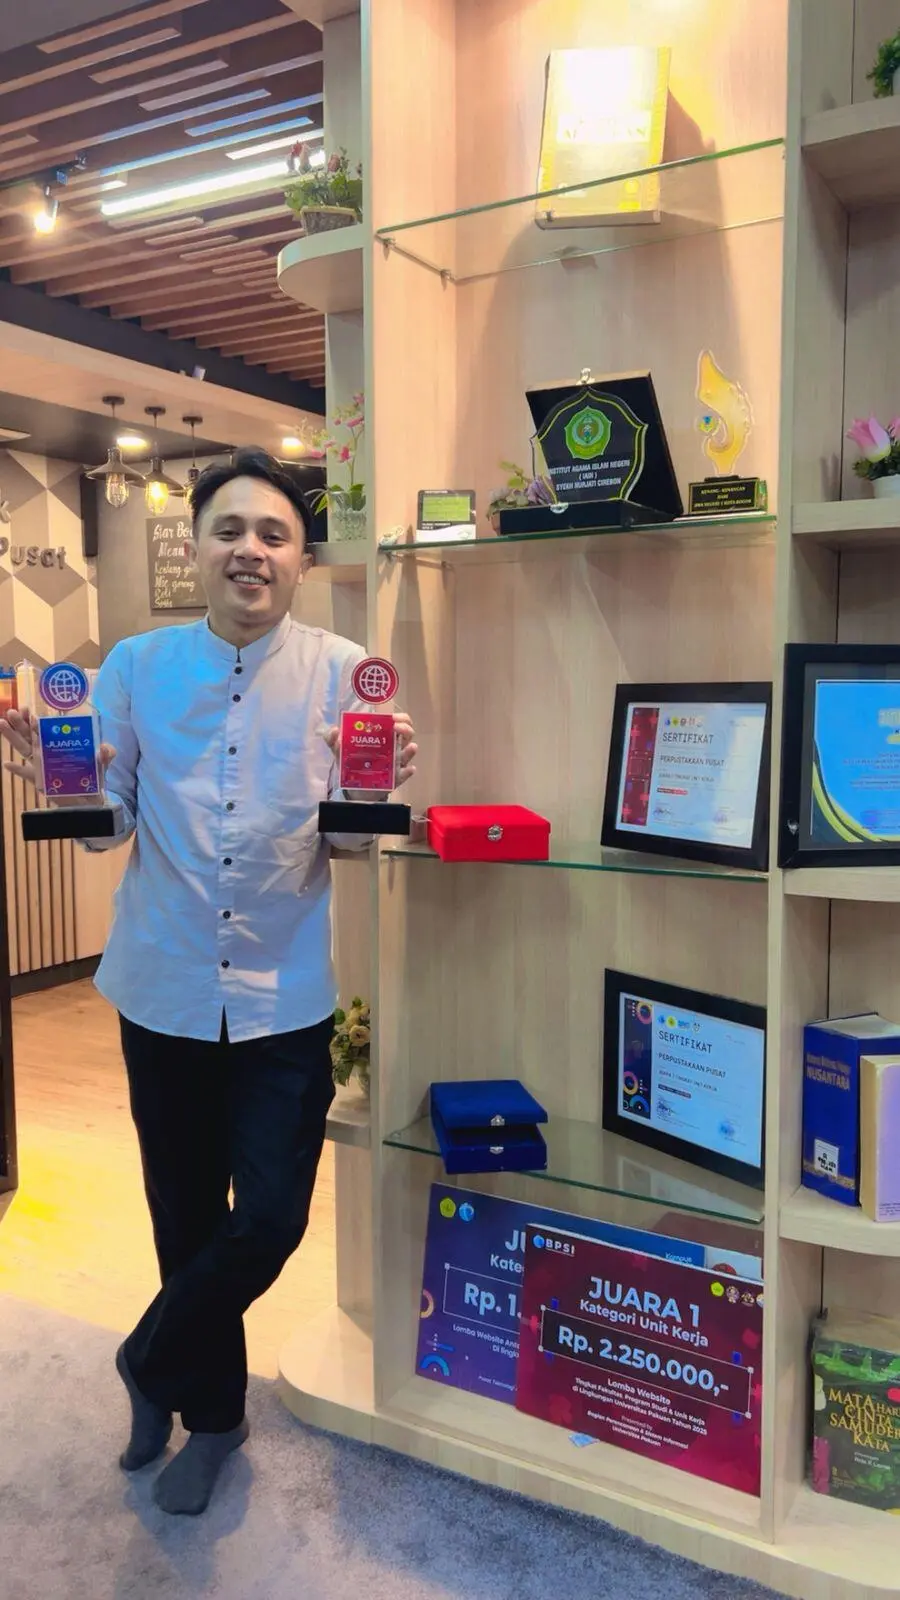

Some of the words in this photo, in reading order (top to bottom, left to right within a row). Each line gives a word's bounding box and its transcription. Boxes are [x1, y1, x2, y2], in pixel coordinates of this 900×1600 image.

[571, 464, 591, 472] AGAMA
[591, 462, 609, 470] ISLAM
[610, 459, 630, 468] NEGERI
[597, 477, 621, 486] CIREBON
[45, 740, 82, 748] JUARA
[350, 736, 381, 744] JUARA
[662, 732, 714, 744] SERTIFIKAT
[660, 755, 704, 765] PERPUSTAKAAN
[704, 759, 725, 767] PUSAT
[658, 1030, 713, 1053] SERTIFIKAT
[658, 1052, 705, 1073] PERPUSTAKAAN
[705, 1066, 727, 1078] PUSAT
[807, 1065, 850, 1090] NUSANTARA
[545, 1238, 575, 1255] BPSI
[490, 1253, 525, 1274] Kate
[464, 1282, 502, 1316] Rp.
[588, 1276, 682, 1324] JUARA
[689, 1303, 700, 1328] 1
[453, 1324, 476, 1337] Lomba
[476, 1330, 505, 1345] Website
[580, 1299, 636, 1326] Kategori
[640, 1316, 669, 1335] Unit
[671, 1326, 709, 1347] Kerja
[558, 1325, 594, 1355] Rp.
[599, 1338, 730, 1397] 2.250.000,-
[575, 1377, 597, 1390] Tingkat
[624, 1393, 651, 1408] Program
[651, 1402, 668, 1413] Studi
[674, 1410, 688, 1420] Unit
[688, 1414, 706, 1426] Kerja
[607, 1378, 636, 1394] Lomba
[636, 1387, 671, 1405] Website
[828, 1388, 875, 1412] MATA
[579, 1387, 614, 1403] Lingkungan
[614, 1399, 647, 1415] Universitas
[647, 1410, 671, 1423] Pakuan
[671, 1418, 692, 1430] Tahun
[692, 1424, 708, 1436] 2025
[844, 1404, 893, 1428] CINTA
[612, 1425, 640, 1440] Universitas
[640, 1435, 661, 1447] Pakuan
[663, 1436, 689, 1449] Informasi
[853, 1430, 890, 1453] KATA
